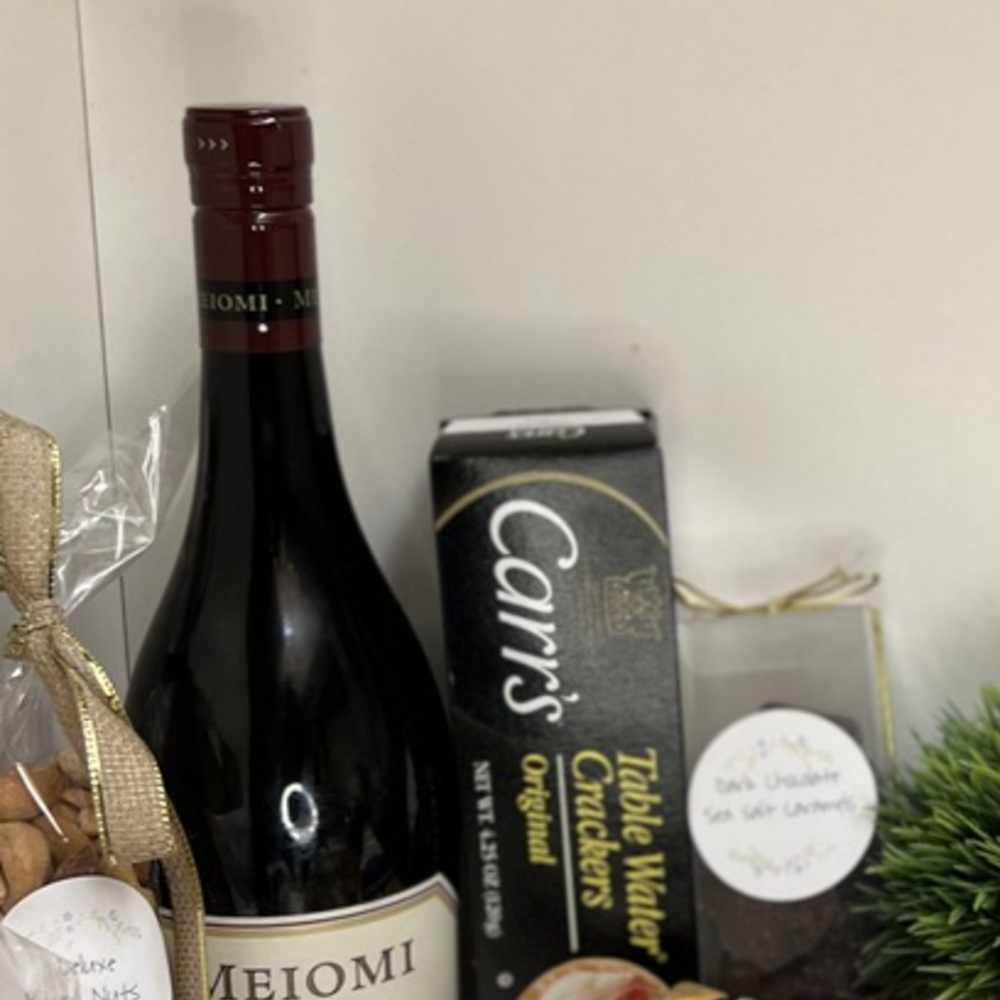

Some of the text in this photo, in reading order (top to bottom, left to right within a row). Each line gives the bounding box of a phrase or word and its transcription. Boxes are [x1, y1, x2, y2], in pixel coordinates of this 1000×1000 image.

[489, 498, 580, 723] Carr's
[515, 753, 558, 866] Original
[570, 750, 622, 909] Crackers
[616, 747, 667, 957] Table Water
